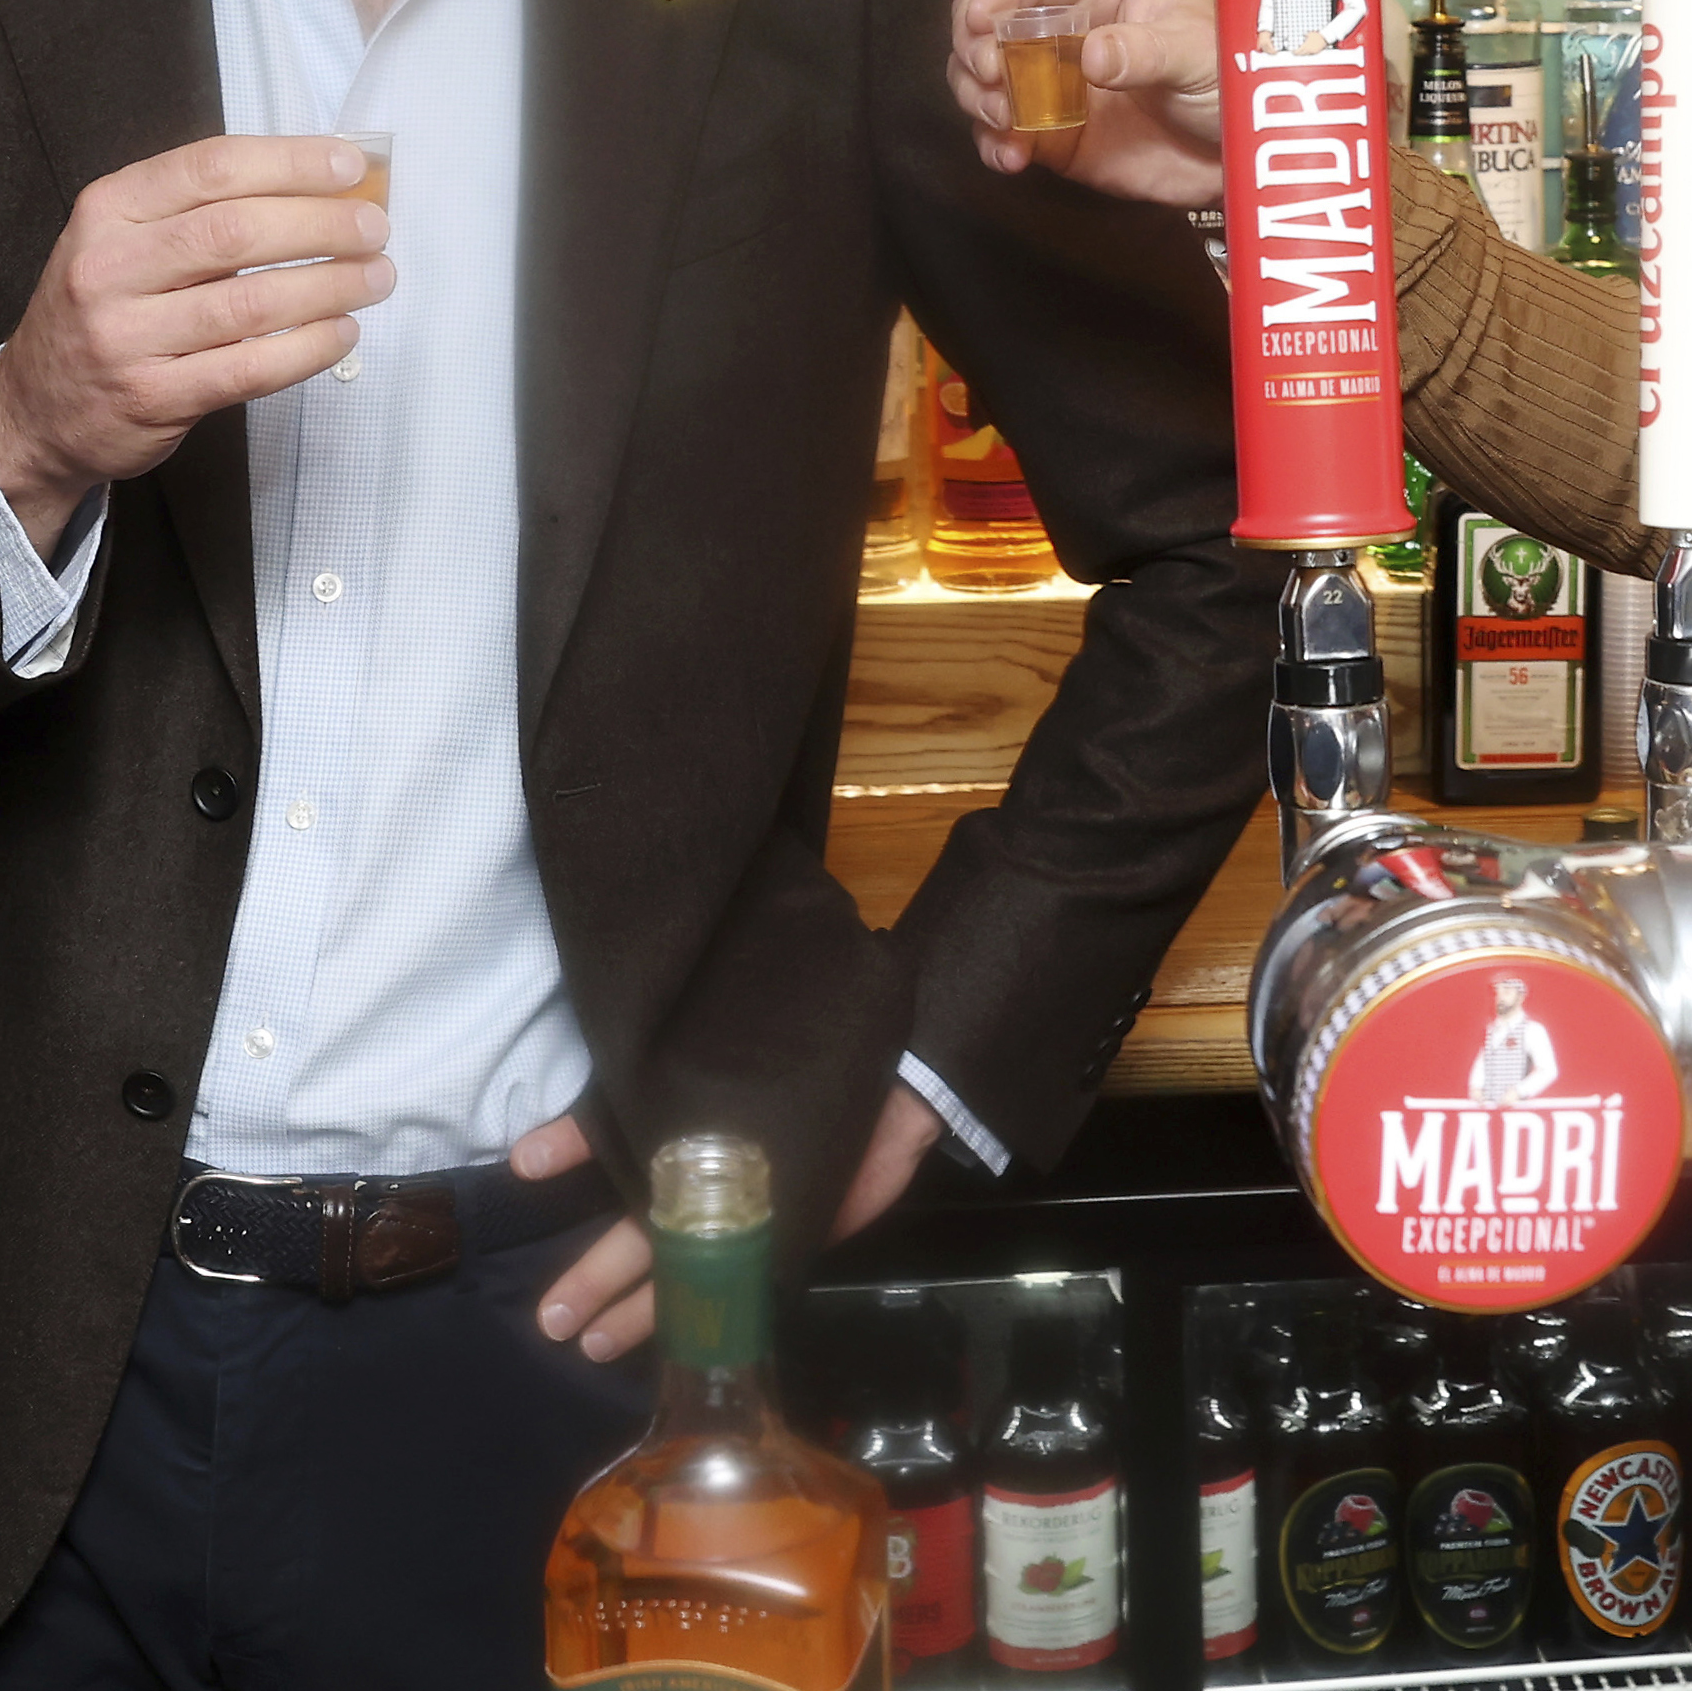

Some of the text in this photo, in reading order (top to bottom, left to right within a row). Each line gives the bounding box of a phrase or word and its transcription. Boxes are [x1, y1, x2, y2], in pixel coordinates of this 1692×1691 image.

[1475, 149, 1536, 173] BUCA
[1234, 44, 1377, 328] MADRÍ
[1262, 327, 1379, 358] EXCEPCIONAL
[1264, 375, 1381, 399] EL ALMA DE MADRID
[1323, 589, 1343, 606] 22
[1509, 667, 1529, 685] 56
[1375, 1093, 1625, 1214] MADRÍ
[1402, 1216, 1586, 1253] EXCEPCIONAL
[1577, 1561, 1662, 1621] BROWN
